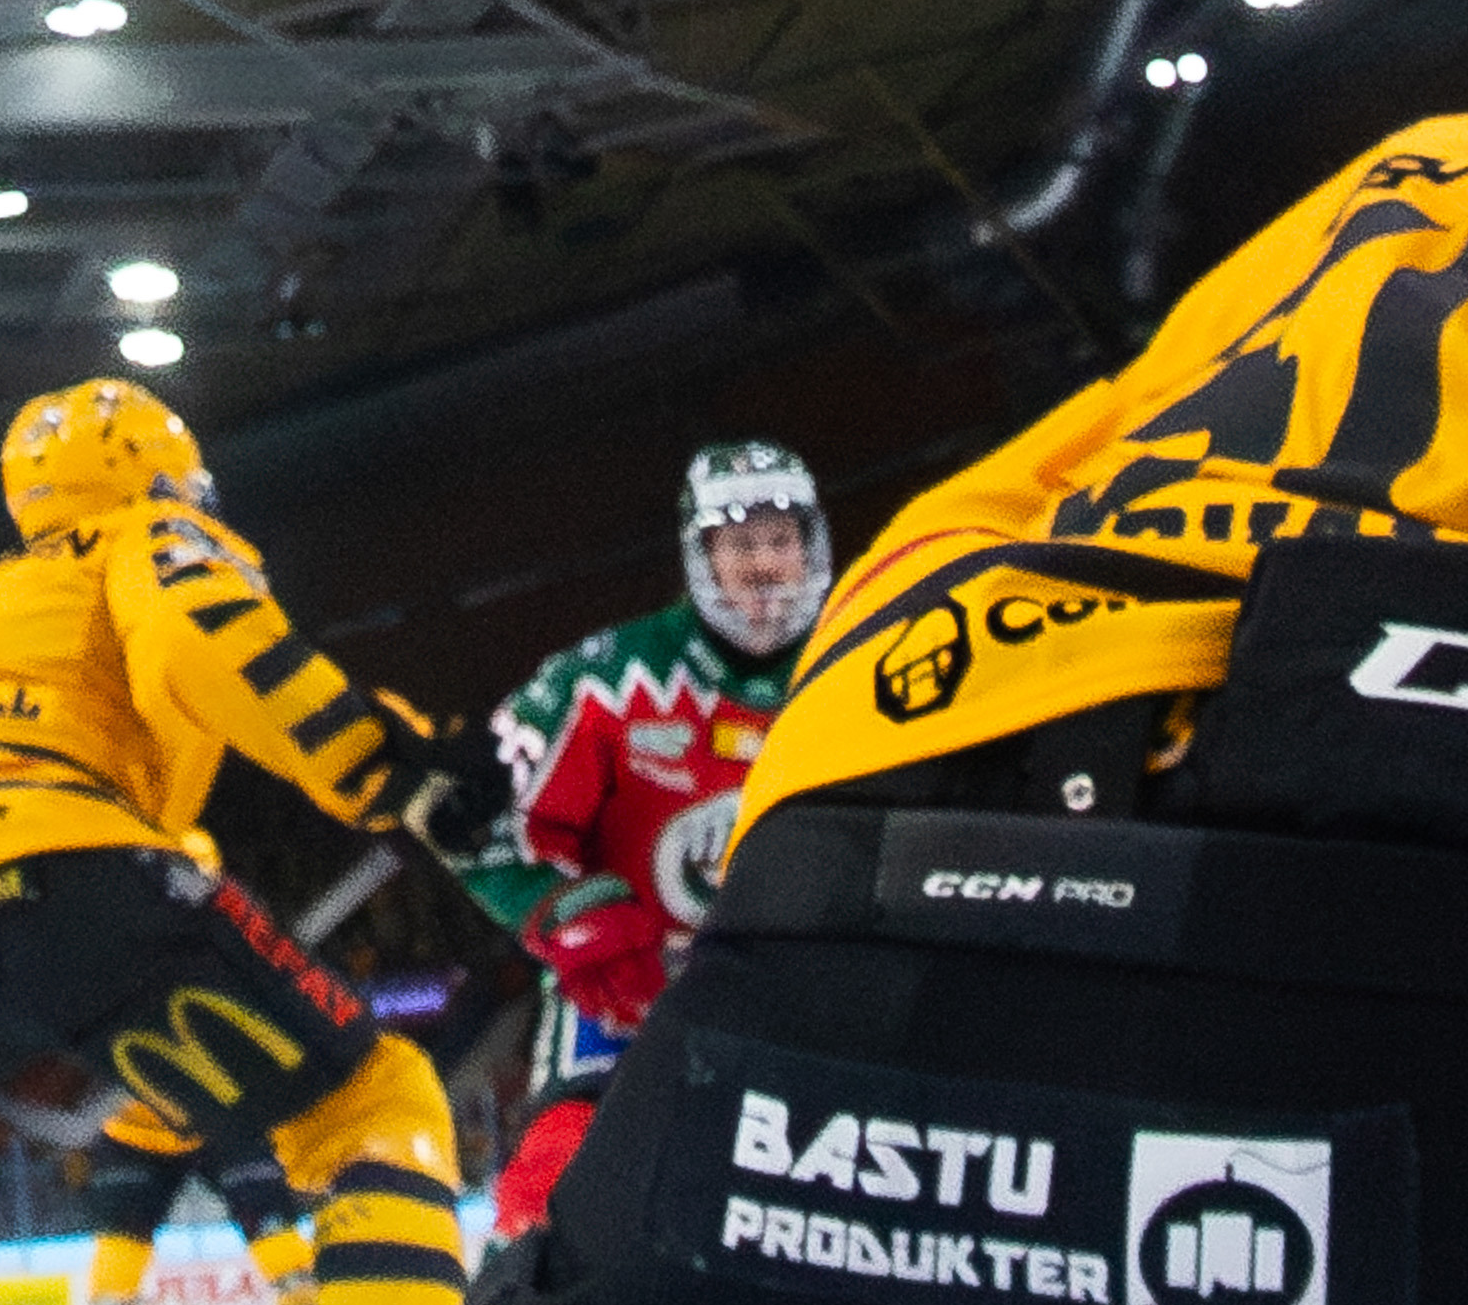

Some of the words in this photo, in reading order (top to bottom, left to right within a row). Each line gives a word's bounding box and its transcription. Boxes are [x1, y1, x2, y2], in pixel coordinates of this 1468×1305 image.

[922, 870, 1044, 901] CCM
[1053, 877, 1135, 909] PRO
[733, 1089, 1055, 1218] BASTU
